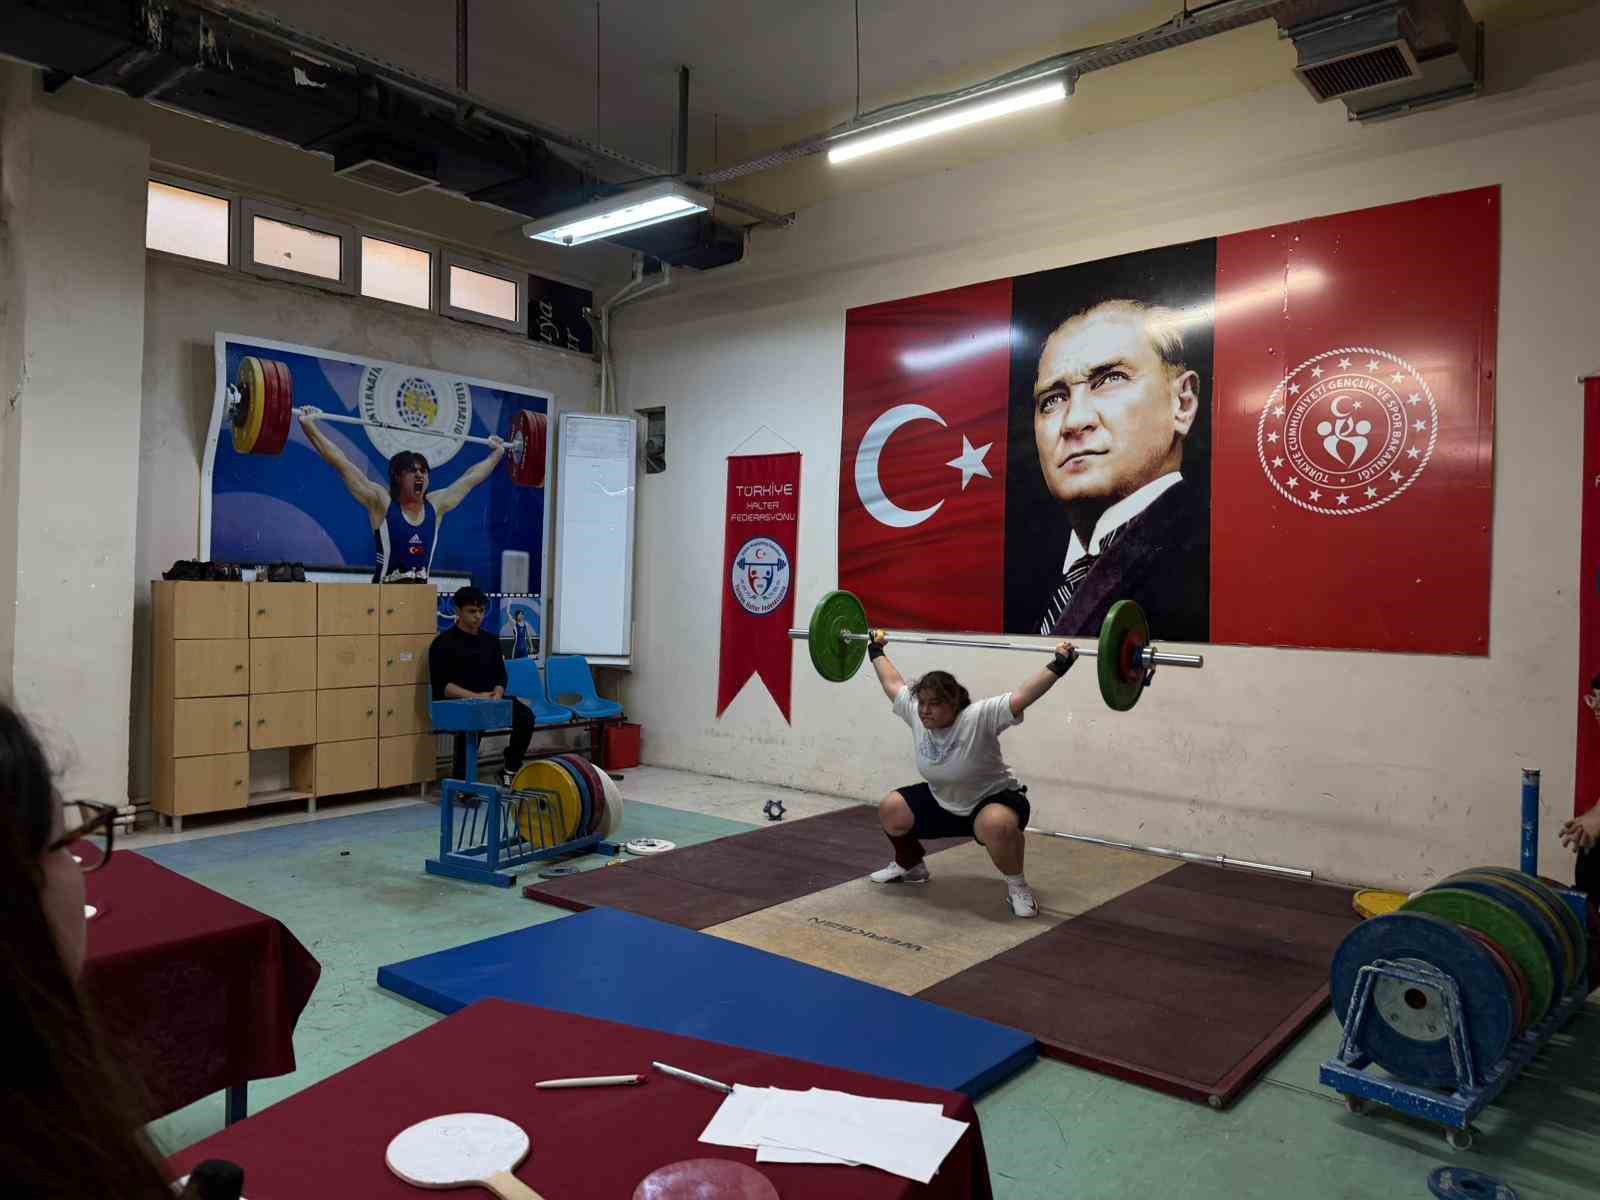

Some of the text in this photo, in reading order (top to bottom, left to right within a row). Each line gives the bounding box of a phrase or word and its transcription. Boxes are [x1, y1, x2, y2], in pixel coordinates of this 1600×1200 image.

[1288, 378, 1402, 483] TÜRKİYE CUMHURİYETİ GENÇLİK VE SPOR BAKANLIĞI
[735, 482, 793, 497] TÜRKİYE
[746, 501, 780, 510] HALTER
[731, 512, 796, 522] FEDERASYONU
